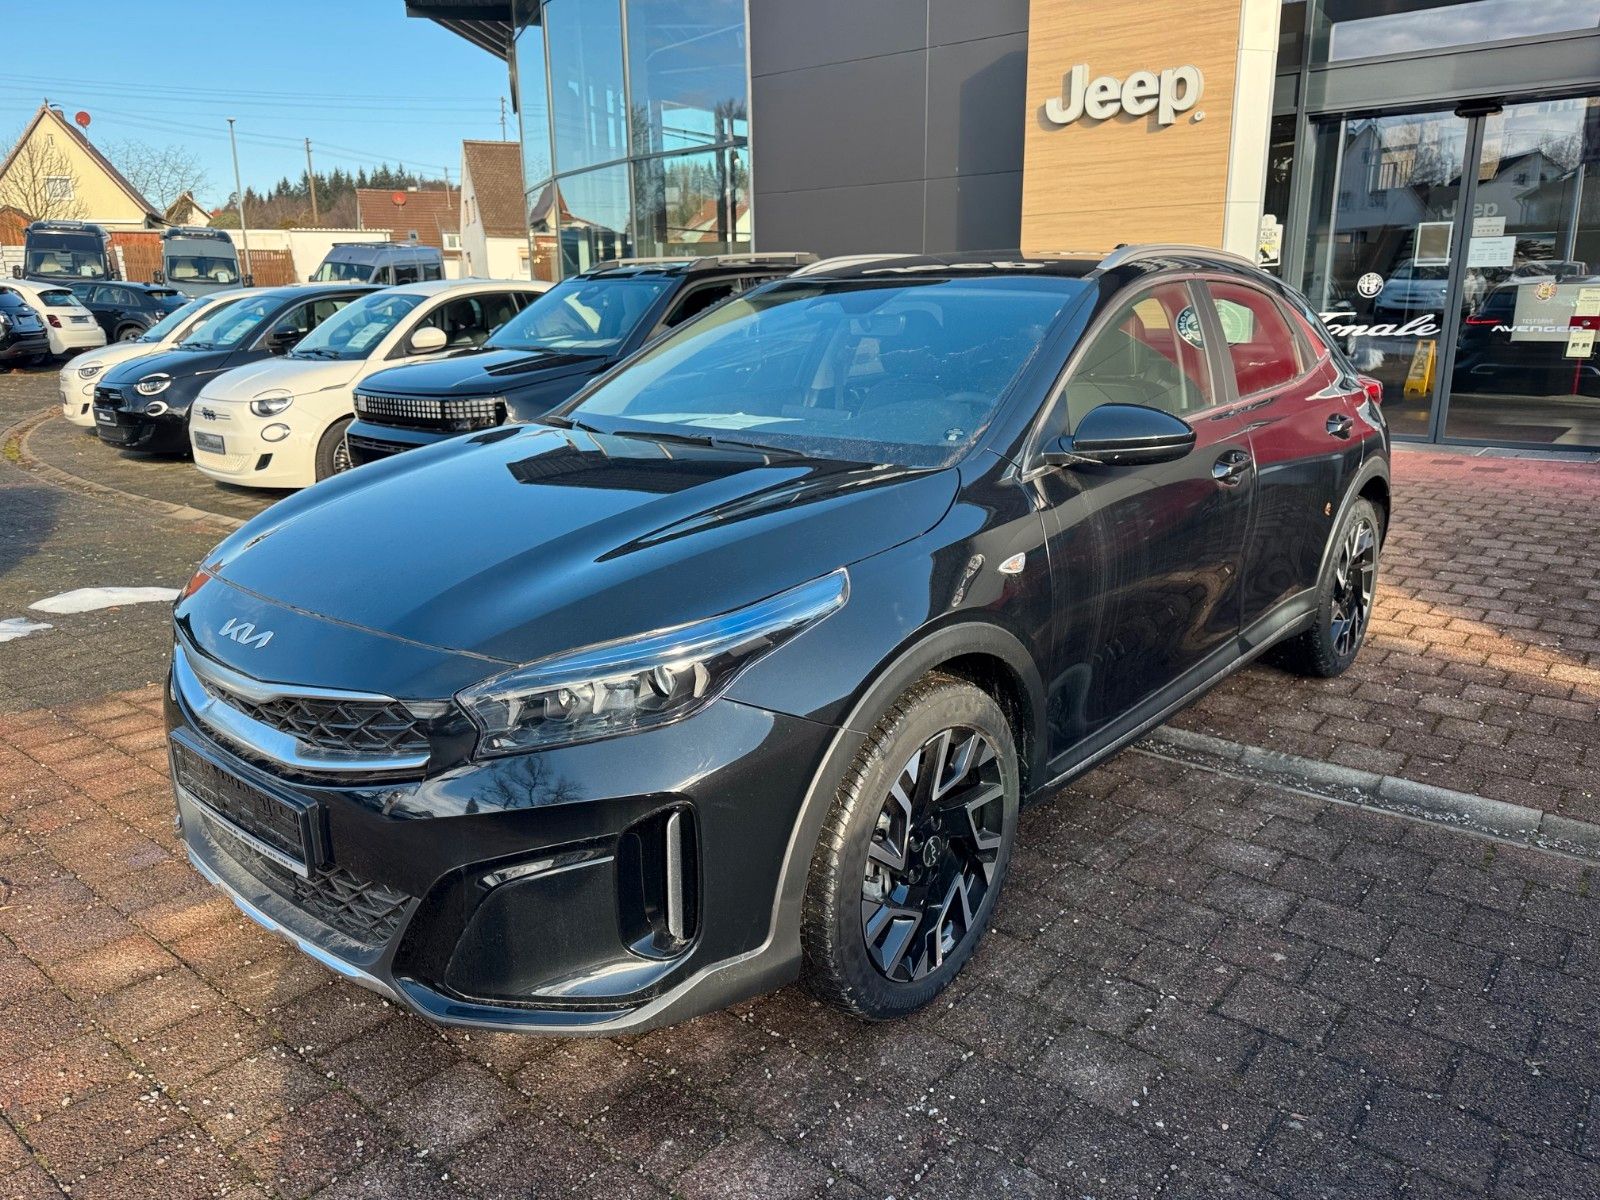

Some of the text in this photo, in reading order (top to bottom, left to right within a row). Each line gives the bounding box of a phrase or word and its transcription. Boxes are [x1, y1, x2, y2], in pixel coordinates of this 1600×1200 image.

[1045, 64, 1204, 125] Jeep
[1442, 200, 1498, 217] Jep
[218, 617, 275, 649] KIA
